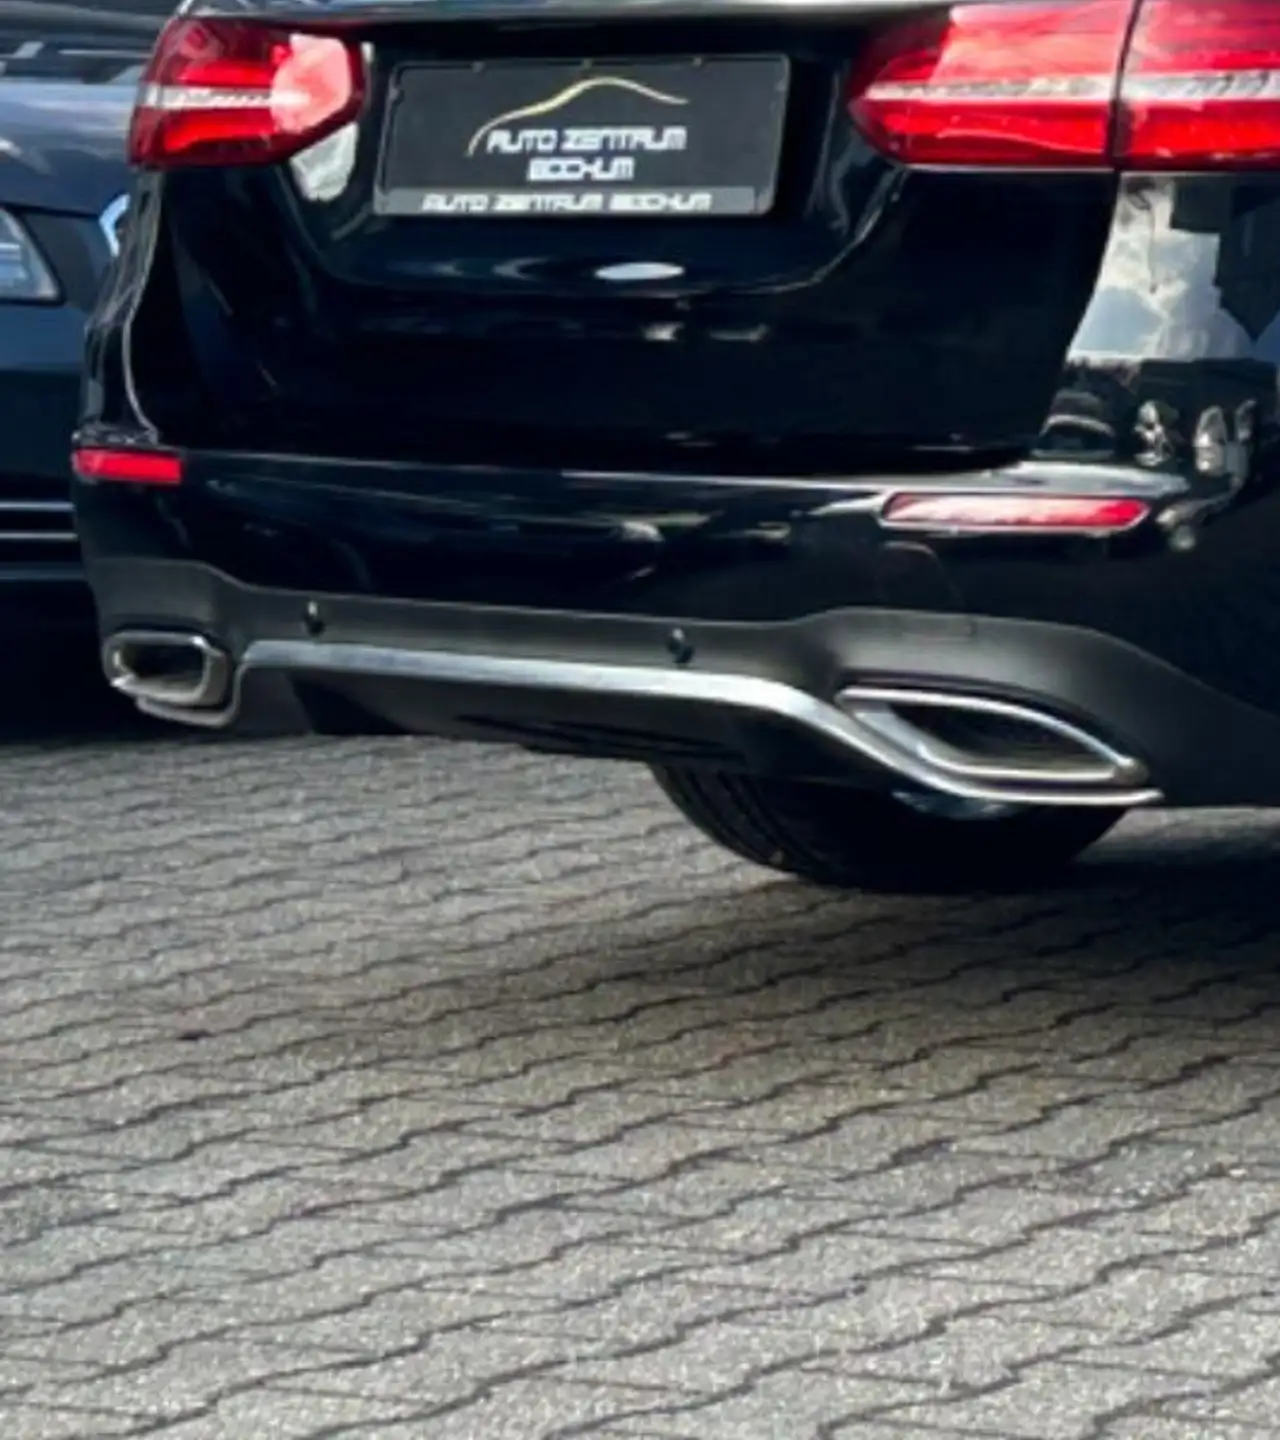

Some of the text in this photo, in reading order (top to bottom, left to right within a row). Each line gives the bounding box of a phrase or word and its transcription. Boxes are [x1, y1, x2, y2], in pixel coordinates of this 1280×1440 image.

[486, 125, 687, 153] AUTO ZENTRUM
[527, 156, 634, 181] BOCHUM
[421, 192, 713, 212] AUTO ZENTRUM BOCHUM
